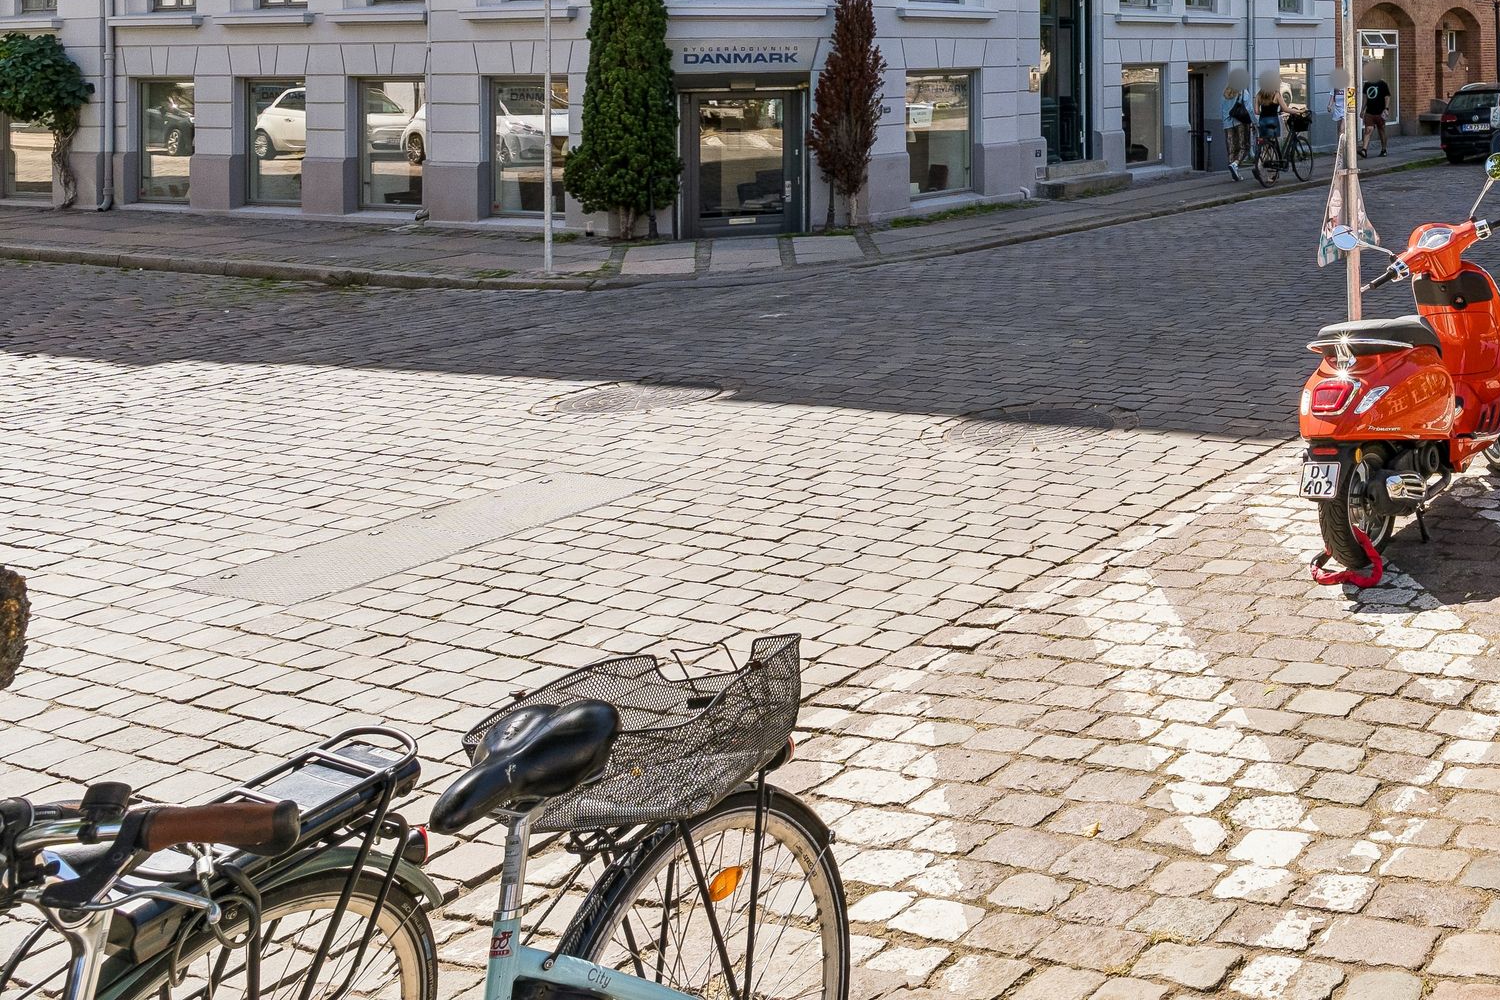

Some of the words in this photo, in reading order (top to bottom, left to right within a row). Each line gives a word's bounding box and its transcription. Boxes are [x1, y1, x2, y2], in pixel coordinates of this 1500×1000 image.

[683, 52, 798, 64] DANMARK
[1310, 465, 1331, 479] DJ
[1303, 480, 1333, 495] 402
[587, 967, 612, 988] City
